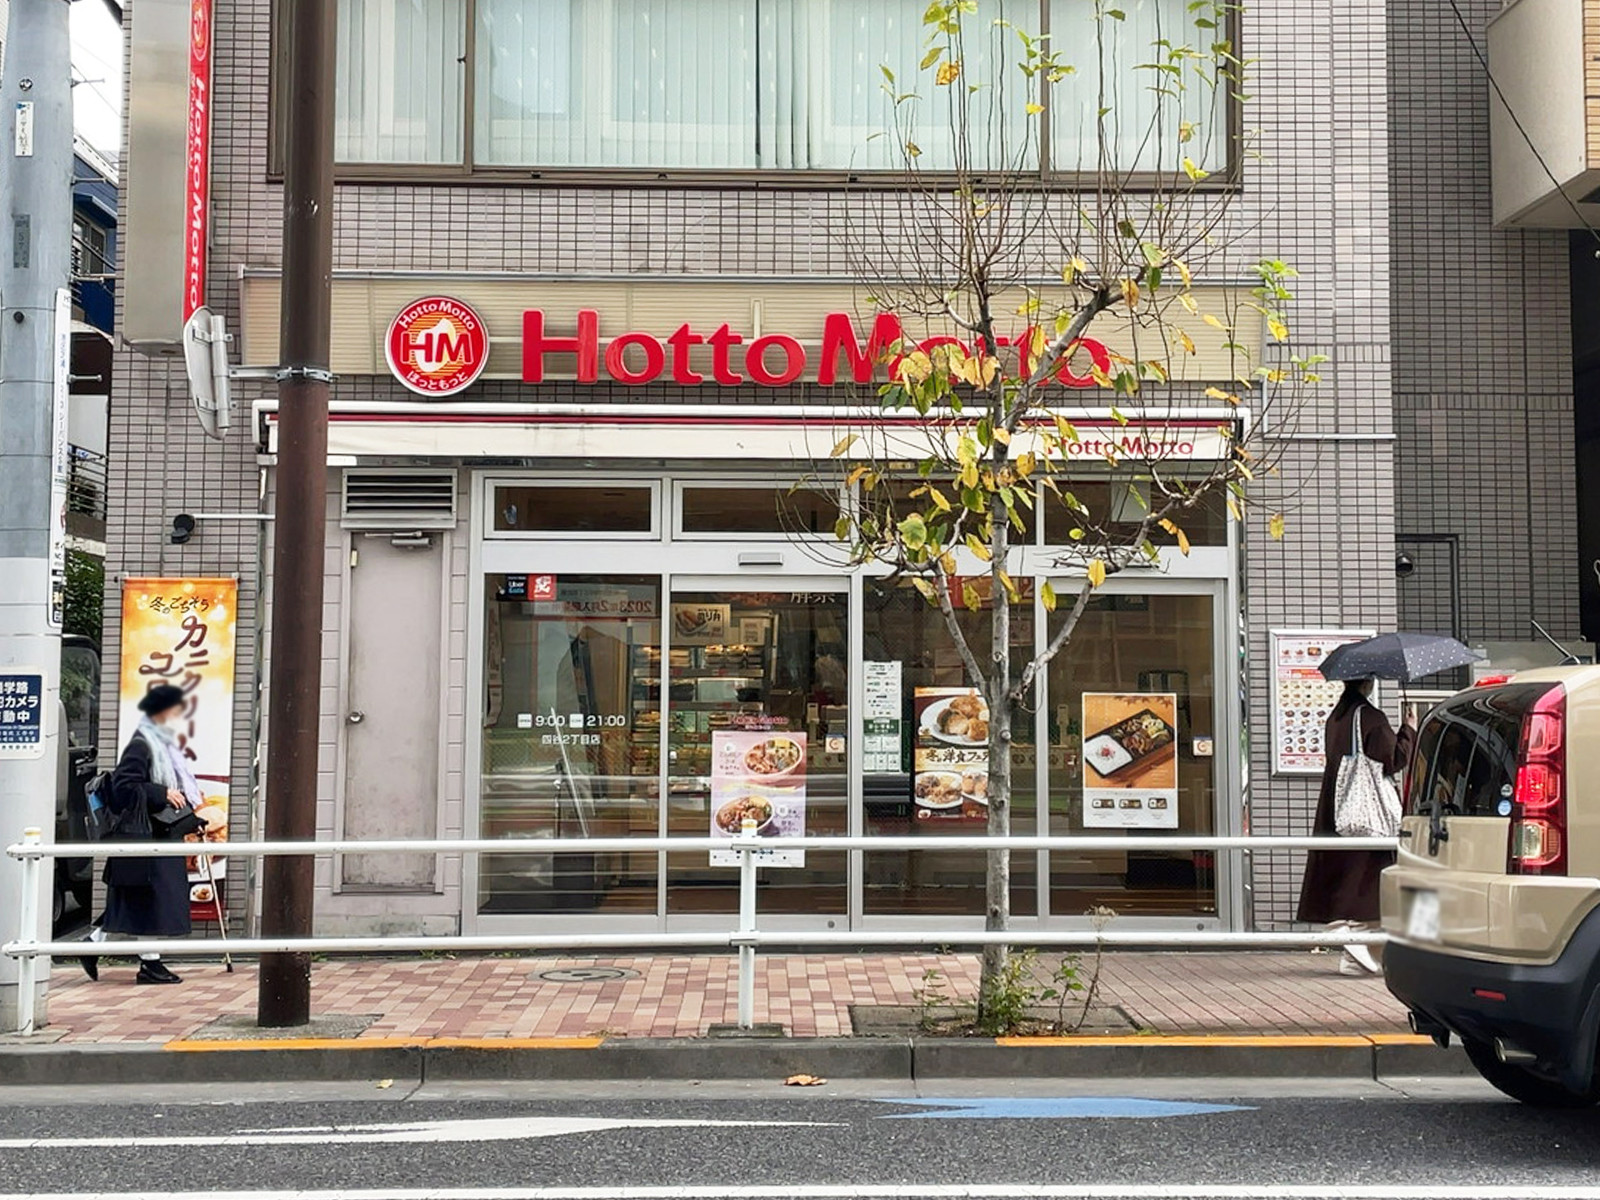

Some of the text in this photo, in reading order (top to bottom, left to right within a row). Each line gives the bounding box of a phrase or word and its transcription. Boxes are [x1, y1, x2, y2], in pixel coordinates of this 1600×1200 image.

[193, 76, 206, 190] Hotto
[190, 191, 203, 310] Motto
[398, 301, 475, 331] Hotto Motto
[400, 331, 474, 365] HM
[521, 308, 806, 387] Hotto
[406, 370, 468, 390] ほっともっと
[149, 596, 210, 614] 冬のごちそう
[0, 709, 31, 723] 動中
[535, 714, 626, 727] 9:00 21:00
